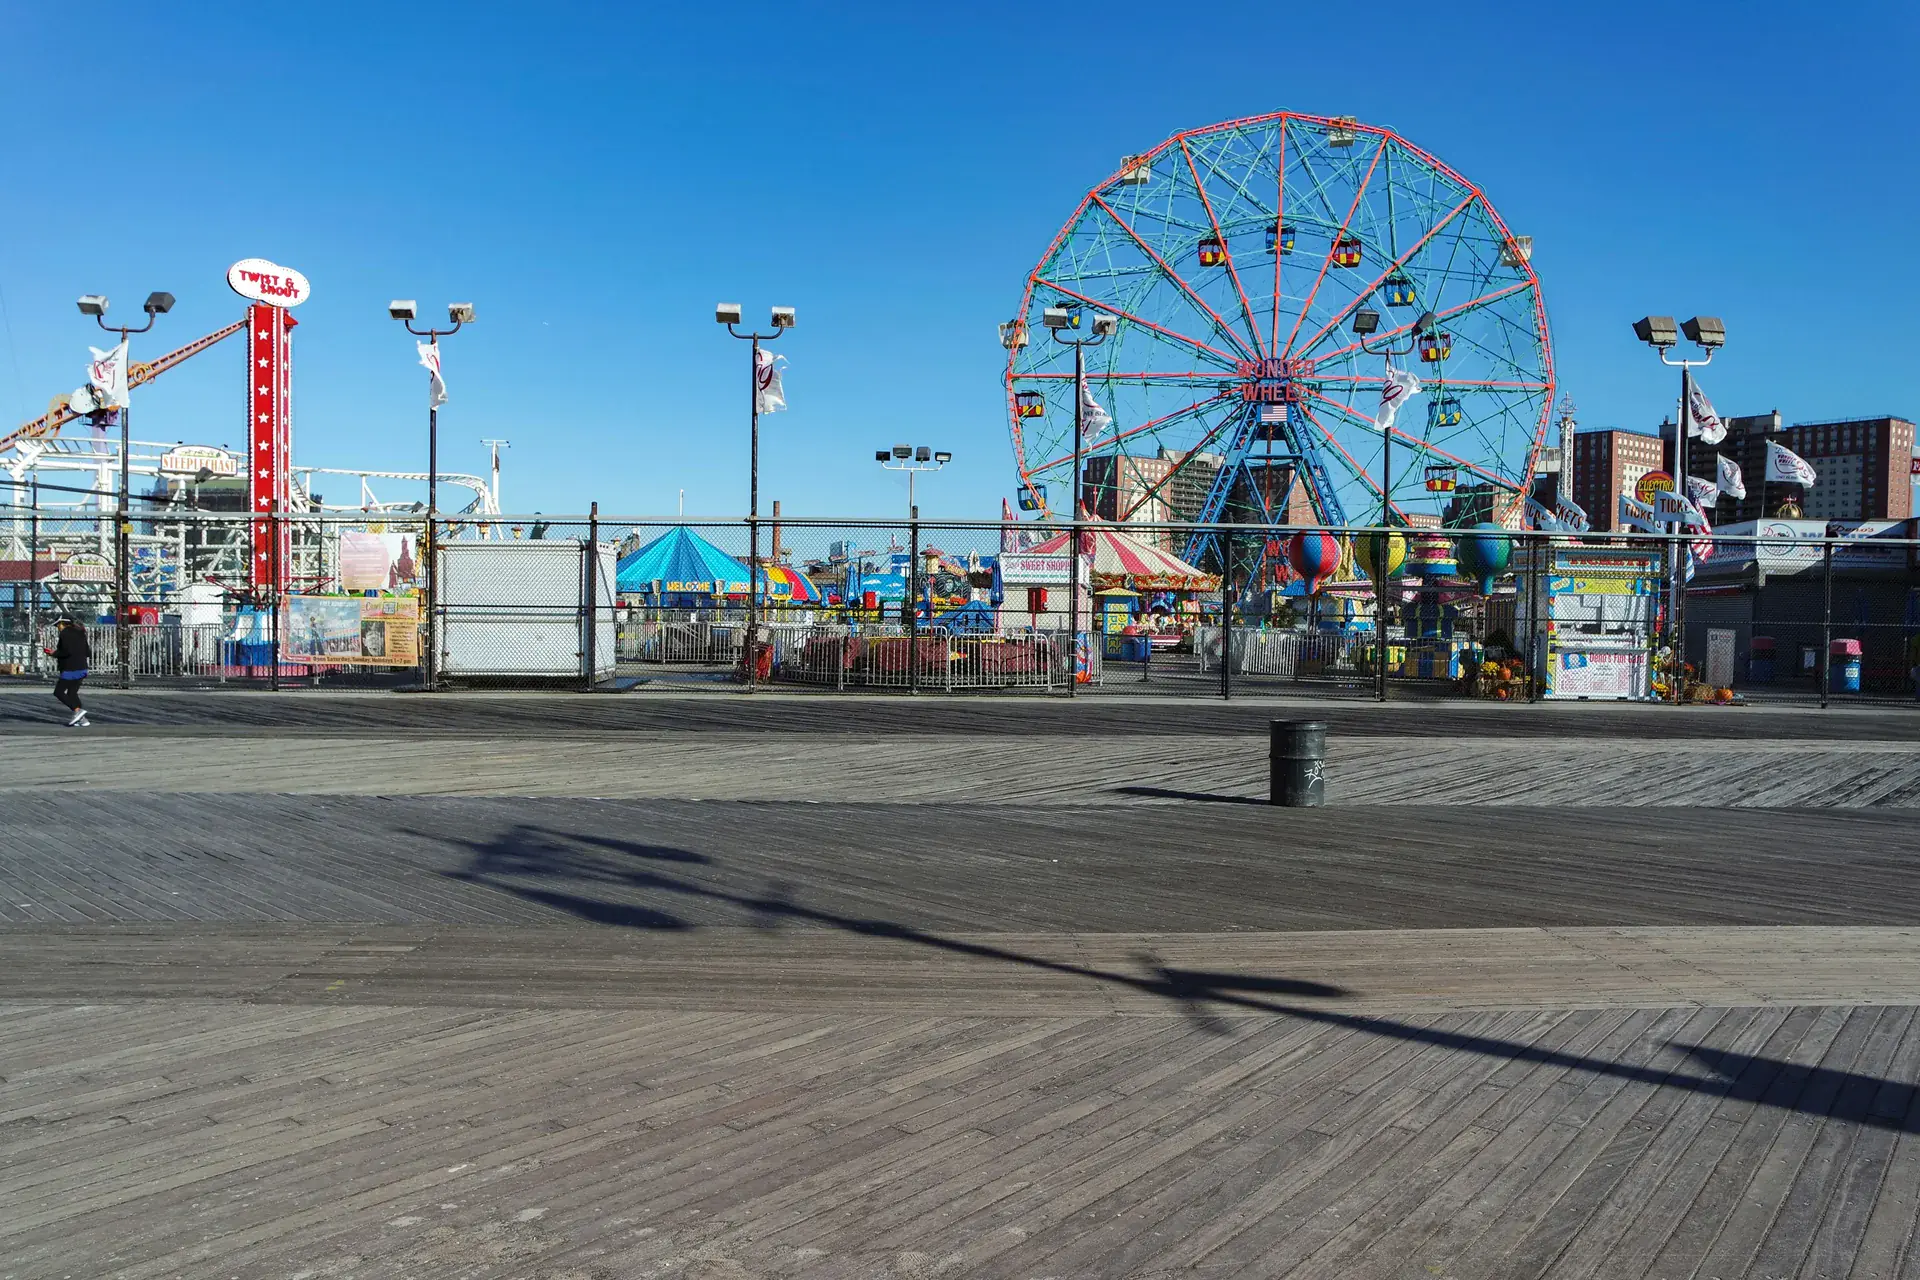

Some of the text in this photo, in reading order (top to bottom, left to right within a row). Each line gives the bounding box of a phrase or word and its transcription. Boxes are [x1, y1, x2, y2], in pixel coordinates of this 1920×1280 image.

[239, 269, 280, 286] TWIST
[260, 283, 300, 298] SHOUT
[1235, 358, 1316, 378] WONDER
[1241, 382, 1309, 402] WHEEL
[163, 455, 236, 473] STEEPLECHASE
[1638, 480, 1675, 492] ELECTRO
[1833, 524, 1875, 533] Deno's
[1020, 559, 1045, 571] SWEET
[1046, 560, 1071, 571] SHOPP
